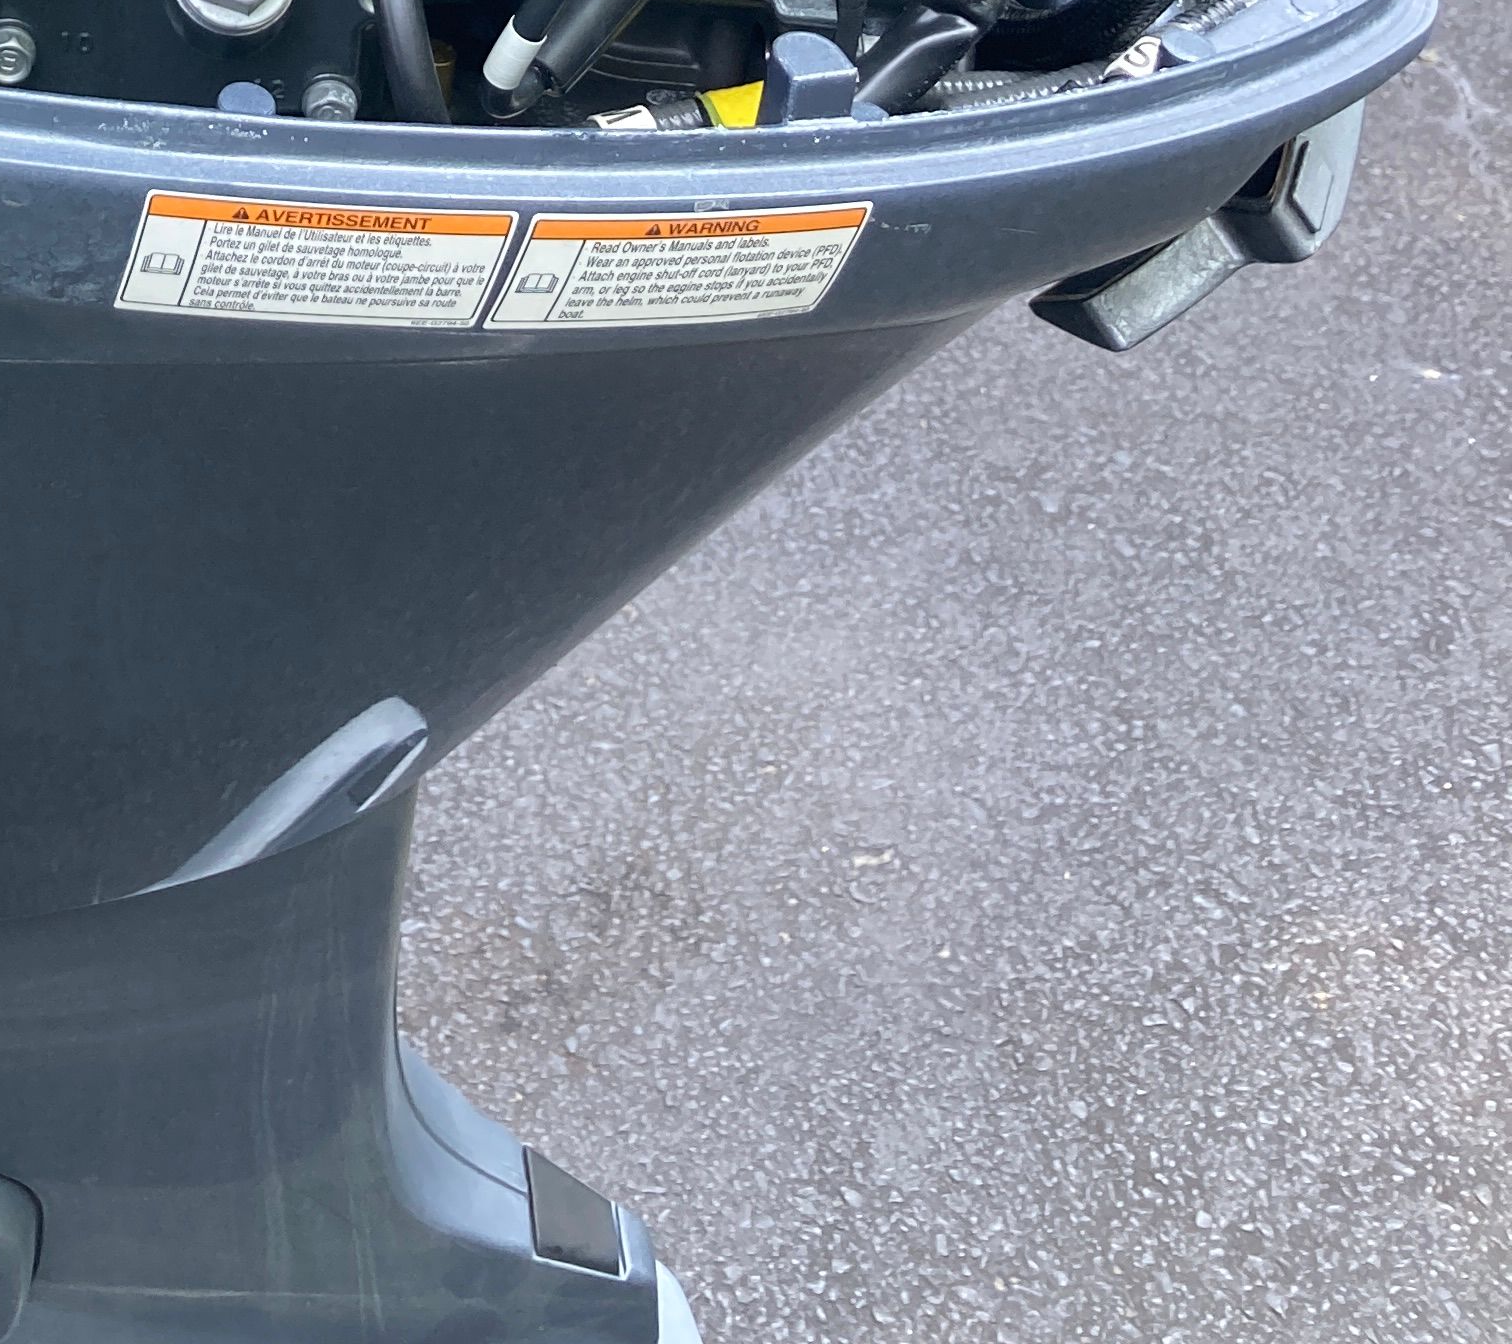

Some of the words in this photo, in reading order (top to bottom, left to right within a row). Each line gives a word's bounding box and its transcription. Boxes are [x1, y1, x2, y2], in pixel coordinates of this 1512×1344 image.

[255, 209, 433, 231] AVERTISSEMENT
[668, 219, 761, 235] WARNING
[213, 222, 233, 235] Lire
[235, 224, 245, 236] le
[246, 225, 282, 239] Manuel
[283, 228, 297, 241] de
[297, 229, 354, 244] l'Utilisateur
[355, 233, 366, 244] et
[367, 233, 381, 245] les
[209, 236, 242, 250] Portez
[243, 240, 256, 251] un
[258, 241, 281, 253] gilet
[281, 242, 295, 254] de
[296, 244, 346, 259] sauvetage
[590, 241, 621, 254] Read
[622, 241, 667, 254] Owner's
[668, 239, 713, 253] Manuals
[714, 238, 737, 251] and
[737, 236, 770, 249] labels.
[204, 248, 249, 264] Attachez
[249, 253, 260, 264] le
[261, 253, 296, 266] cordon
[331, 258, 345, 269] du
[346, 259, 381, 272] moteur
[381, 260, 452, 275] (coupe-circuit)
[452, 262, 460, 273] à
[461, 263, 486, 274] votre
[586, 256, 615, 268] Wear
[615, 258, 630, 268] an
[631, 255, 685, 270] approved
[682, 253, 733, 269] personal
[732, 251, 776, 263] flotation
[776, 248, 812, 260] device
[200, 263, 224, 276] gilet
[224, 263, 238, 274] de
[238, 266, 290, 282] sauvetage,
[292, 269, 300, 280] à
[300, 270, 327, 281] votre
[328, 270, 351, 282] bras
[351, 273, 365, 283] ou
[366, 272, 373, 283] à
[375, 273, 400, 284] votre
[399, 274, 431, 287] jambe
[431, 276, 456, 288] pour
[455, 276, 475, 288] que
[475, 275, 486, 286] le
[578, 270, 615, 282] Attach
[616, 272, 653, 284] engine
[654, 267, 699, 280] shut-off
[698, 266, 725, 279] cord
[724, 263, 772, 278] (lanyard)
[772, 263, 785, 274] to
[784, 261, 810, 275] your
[197, 276, 233, 287] moteur
[272, 280, 282, 290] si
[283, 281, 307, 292] vous
[308, 282, 343, 294] quittez
[343, 284, 424, 297] accidentellement
[424, 286, 434, 297] la
[435, 286, 463, 298] barre.
[598, 285, 614, 295] or
[614, 284, 631, 297] leg
[632, 284, 646, 294] so
[648, 282, 667, 293] the
[704, 280, 734, 293] stops
[735, 278, 746, 290] if
[744, 278, 765, 292] you
[766, 272, 828, 288] accidentally
[188, 298, 212, 307] sans
[193, 285, 215, 297] Cela
[216, 288, 250, 300] permet
[290, 293, 309, 303] que
[309, 293, 320, 303] le
[321, 293, 354, 305] bateau
[354, 296, 368, 305] ne
[368, 296, 417, 308] poursuive
[417, 298, 430, 308] sa
[431, 298, 457, 308] route
[565, 296, 595, 308] leave
[595, 296, 614, 307] the
[647, 294, 679, 305] which
[680, 292, 713, 304] could
[709, 291, 753, 305] prevent
[751, 291, 762, 301] a
[761, 286, 806, 300] runaway
